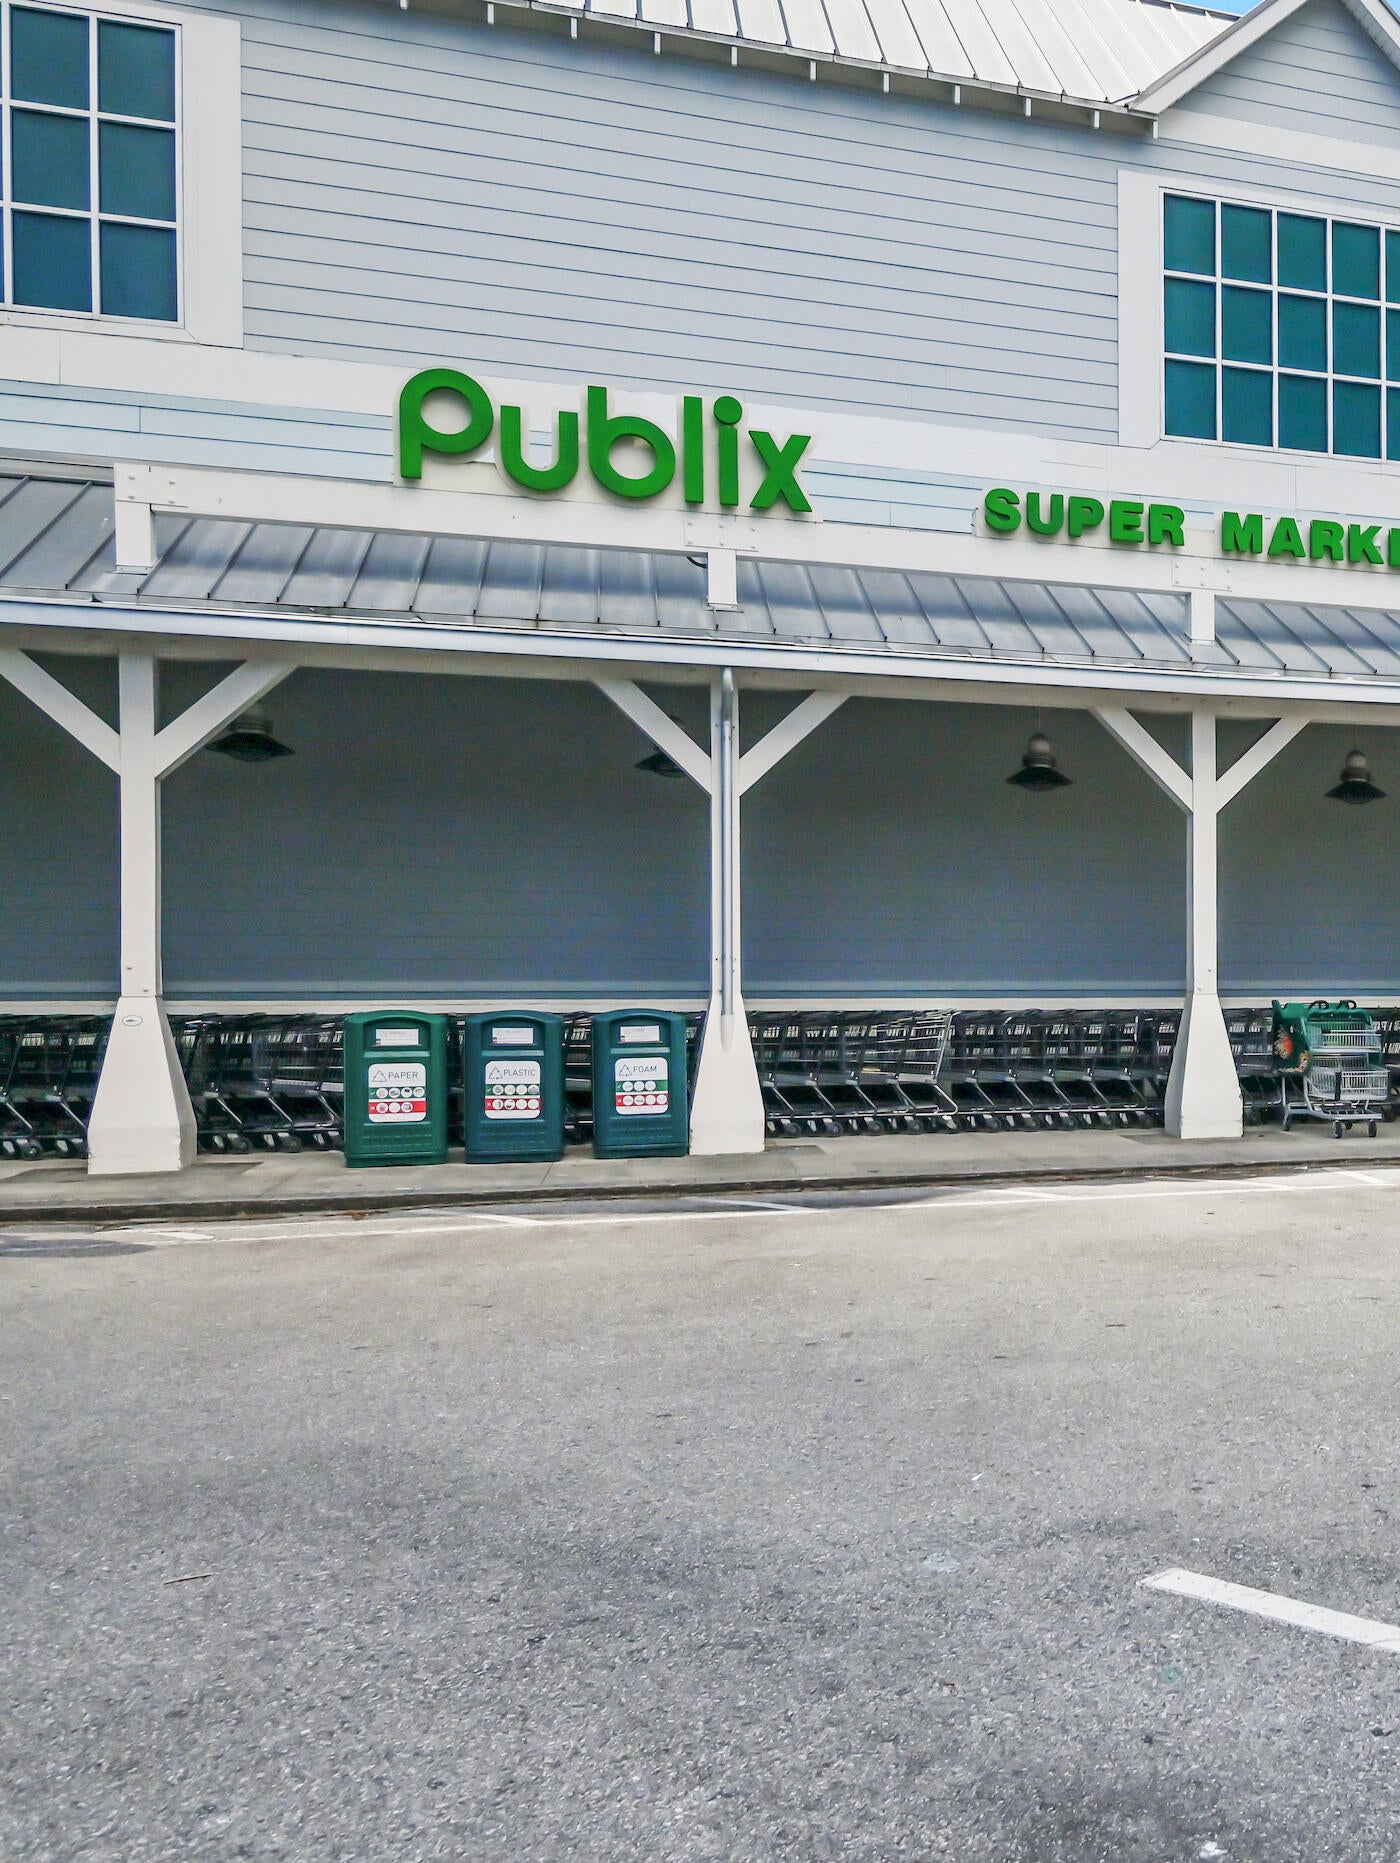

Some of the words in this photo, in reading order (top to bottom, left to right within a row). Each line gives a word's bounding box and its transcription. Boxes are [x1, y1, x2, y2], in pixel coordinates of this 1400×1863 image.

[399, 368, 811, 513] Publix
[985, 487, 1185, 550] SUPER
[503, 1068, 536, 1077] PLASTIC
[633, 1065, 657, 1073] FOAM
[388, 1071, 418, 1080] PAPER
